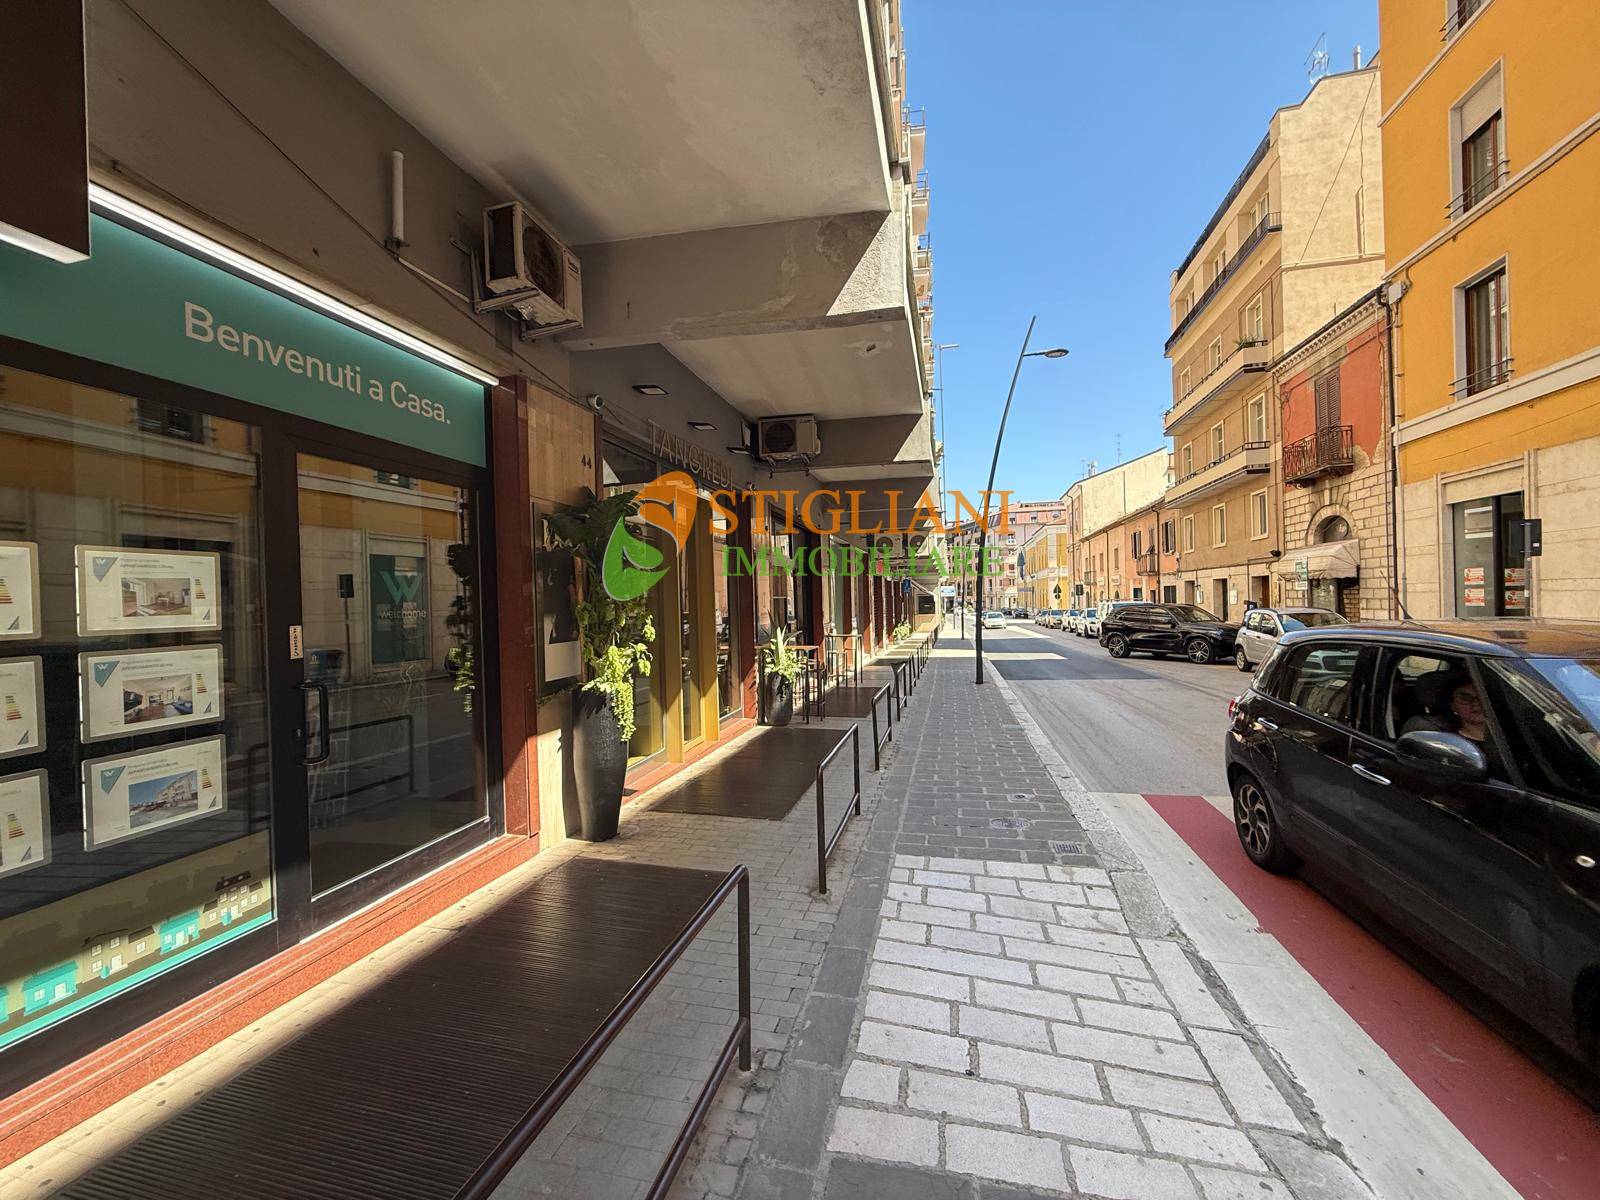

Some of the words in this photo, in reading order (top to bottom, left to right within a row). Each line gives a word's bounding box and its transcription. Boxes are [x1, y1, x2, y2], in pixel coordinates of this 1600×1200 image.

[184, 301, 362, 394] Benvenuti
[368, 378, 384, 402] a
[390, 381, 451, 425] Casa.
[580, 454, 592, 470] 44
[648, 417, 734, 491] TANGREDI
